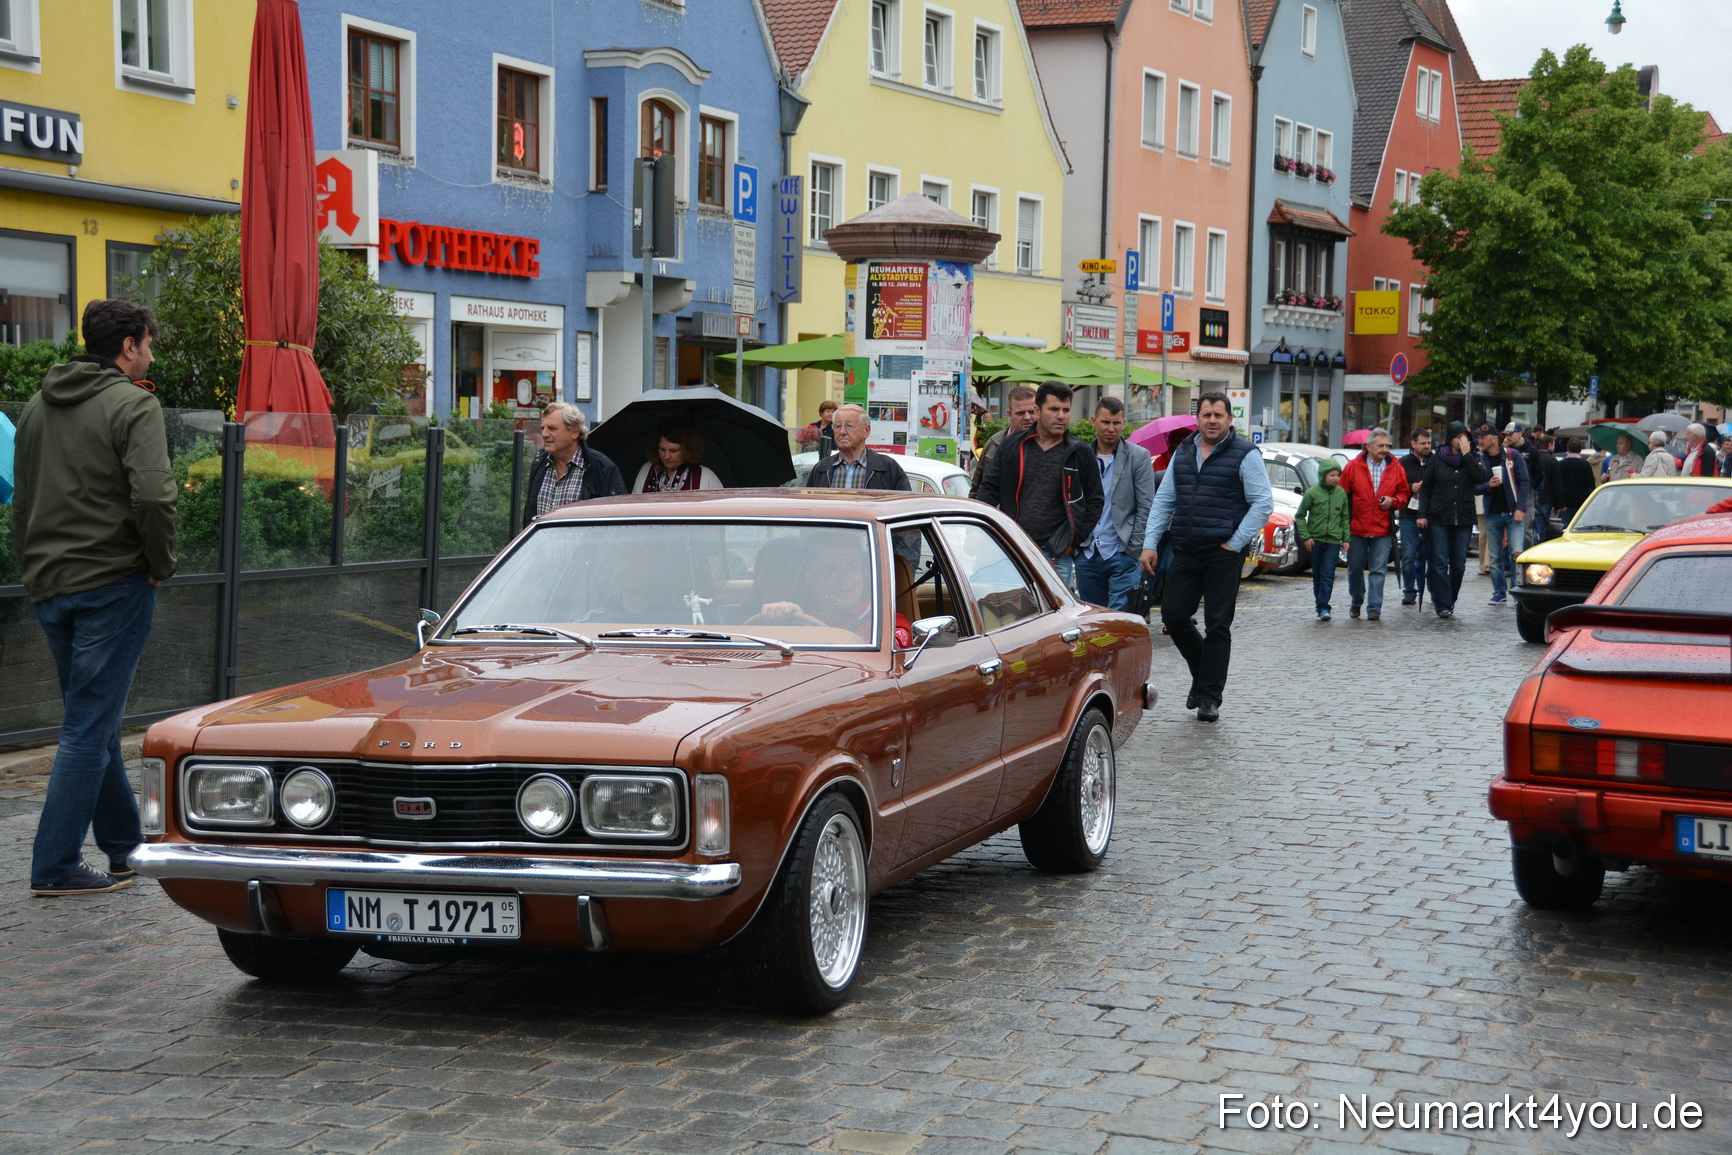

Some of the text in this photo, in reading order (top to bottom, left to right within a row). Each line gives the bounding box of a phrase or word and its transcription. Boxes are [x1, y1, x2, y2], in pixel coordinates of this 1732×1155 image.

[3, 107, 84, 154] FUN
[738, 171, 753, 214] P
[82, 218, 99, 236] 13
[378, 218, 540, 278] POTHEKE
[780, 198, 797, 290] WITTL
[870, 266, 924, 274] NEUMARKTER
[1082, 262, 1099, 270] KINO
[1128, 255, 1136, 287] P
[467, 303, 548, 322] RATHAUS APOTHEKE
[1164, 298, 1172, 328] P
[1573, 718, 1595, 728] Ford
[377, 740, 462, 748] FORD
[397, 802, 431, 815] GXL
[1682, 838, 1689, 846] D
[334, 914, 341, 924] D
[348, 896, 514, 934] NM T 1971 05
[502, 924, 515, 934] 07
[388, 936, 425, 944] FREISTAAT
